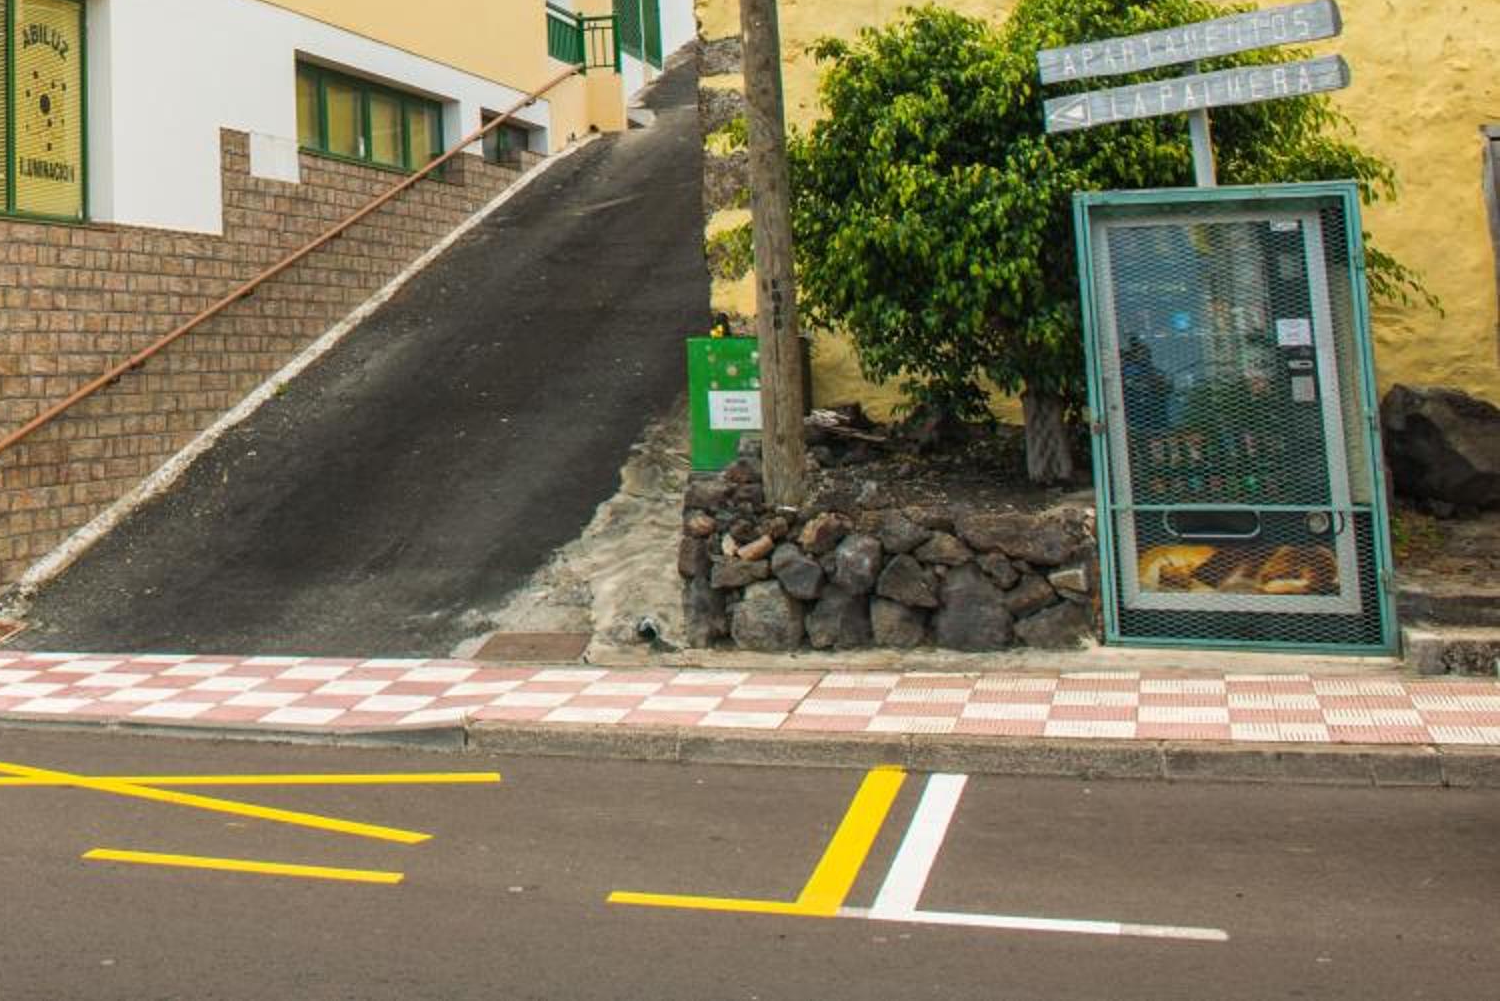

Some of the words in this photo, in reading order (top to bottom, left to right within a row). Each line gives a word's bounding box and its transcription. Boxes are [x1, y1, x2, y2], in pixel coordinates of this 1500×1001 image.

[22, 22, 70, 62] ABILUZ
[1062, 6, 1312, 76] APARTAMENTOS
[1110, 90, 1148, 120] LA
[1159, 65, 1314, 110] PALMERA
